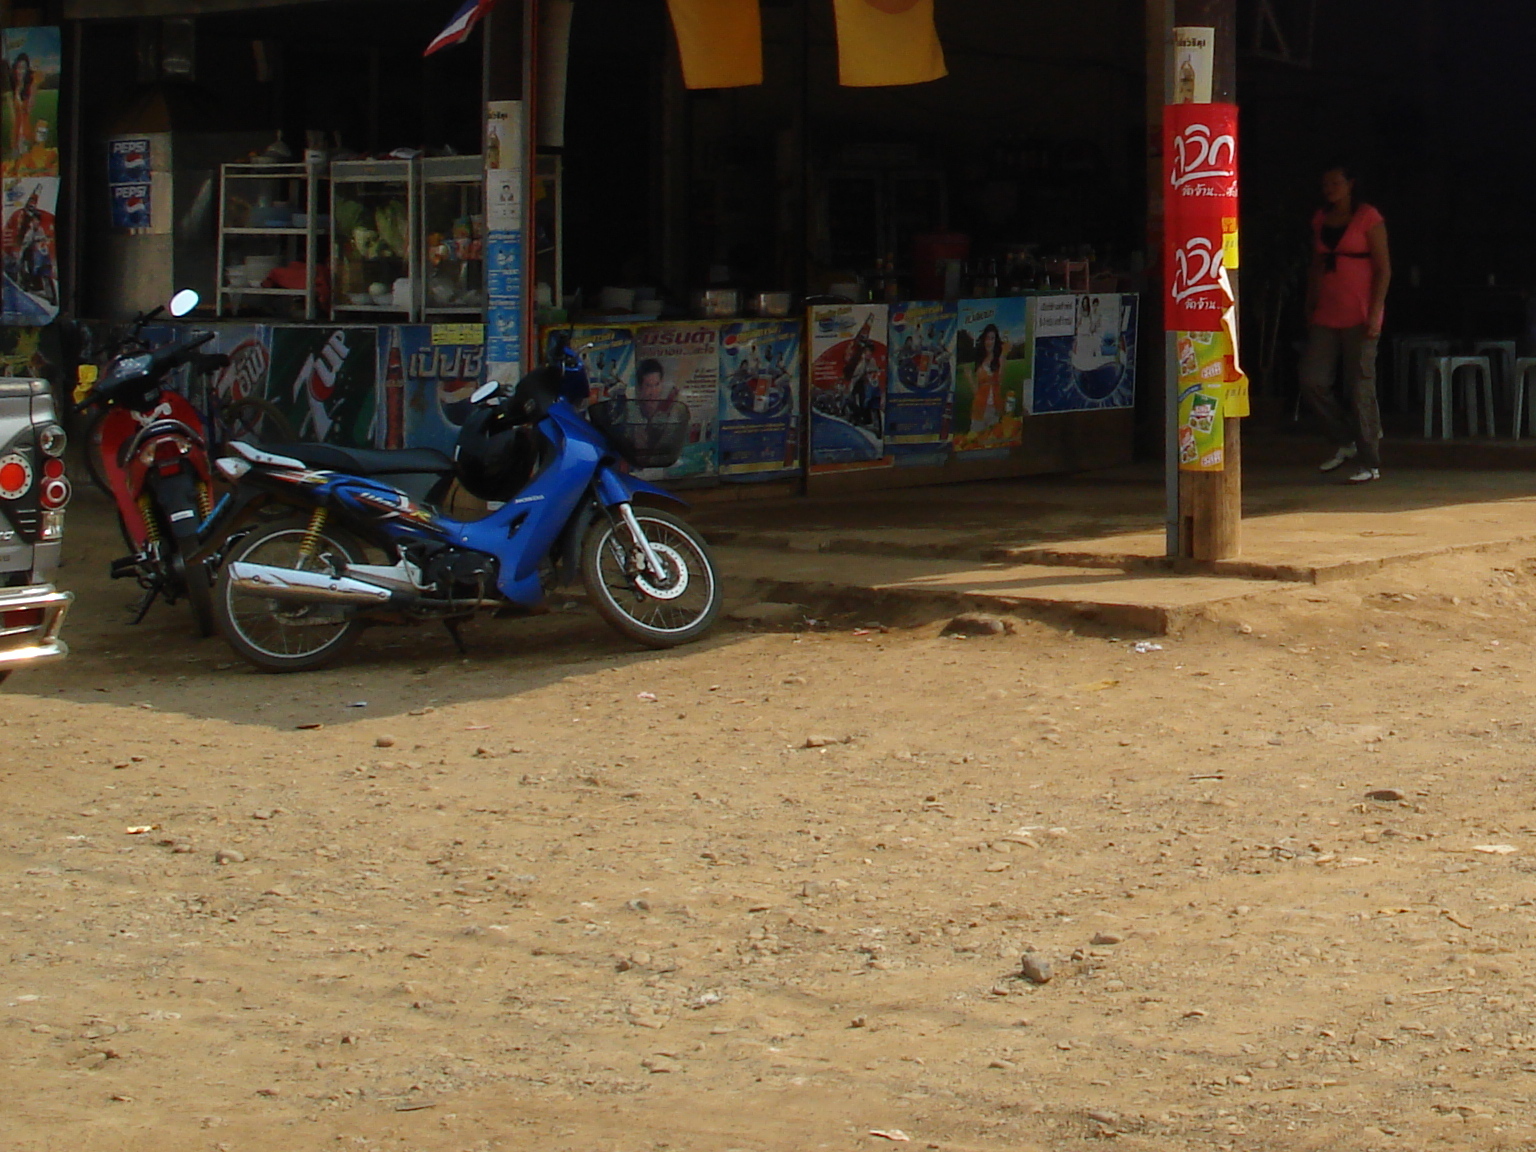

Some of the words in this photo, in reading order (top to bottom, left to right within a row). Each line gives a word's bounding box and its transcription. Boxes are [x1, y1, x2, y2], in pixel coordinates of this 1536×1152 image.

[112, 140, 147, 154] PEPSI
[113, 185, 148, 199] PEPSI
[291, 329, 351, 442] 7UP
